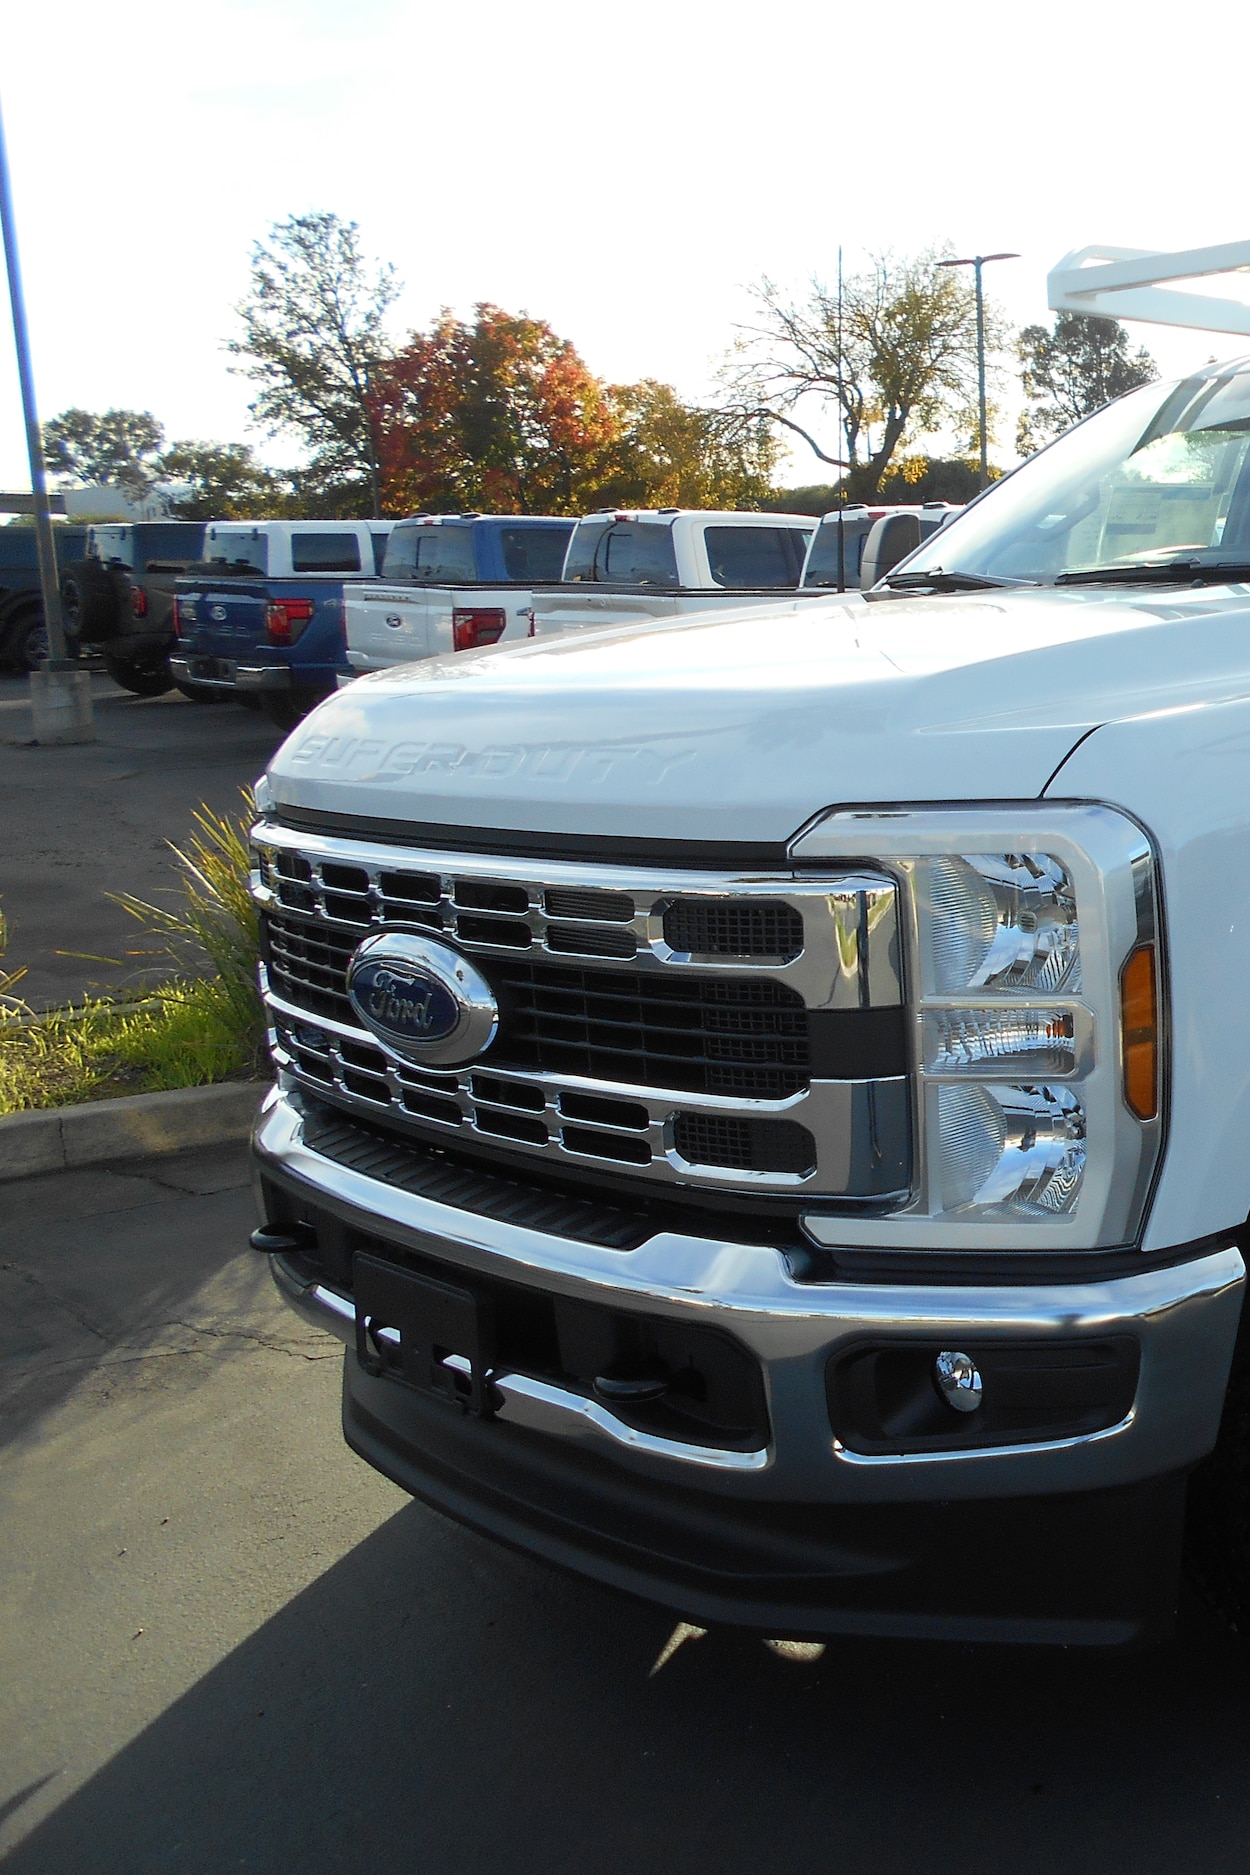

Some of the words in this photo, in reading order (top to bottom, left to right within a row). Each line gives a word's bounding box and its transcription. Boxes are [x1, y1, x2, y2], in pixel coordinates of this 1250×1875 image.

[291, 734, 466, 776] SUPER
[469, 743, 698, 785] DUTY
[368, 969, 434, 1030] Ford
